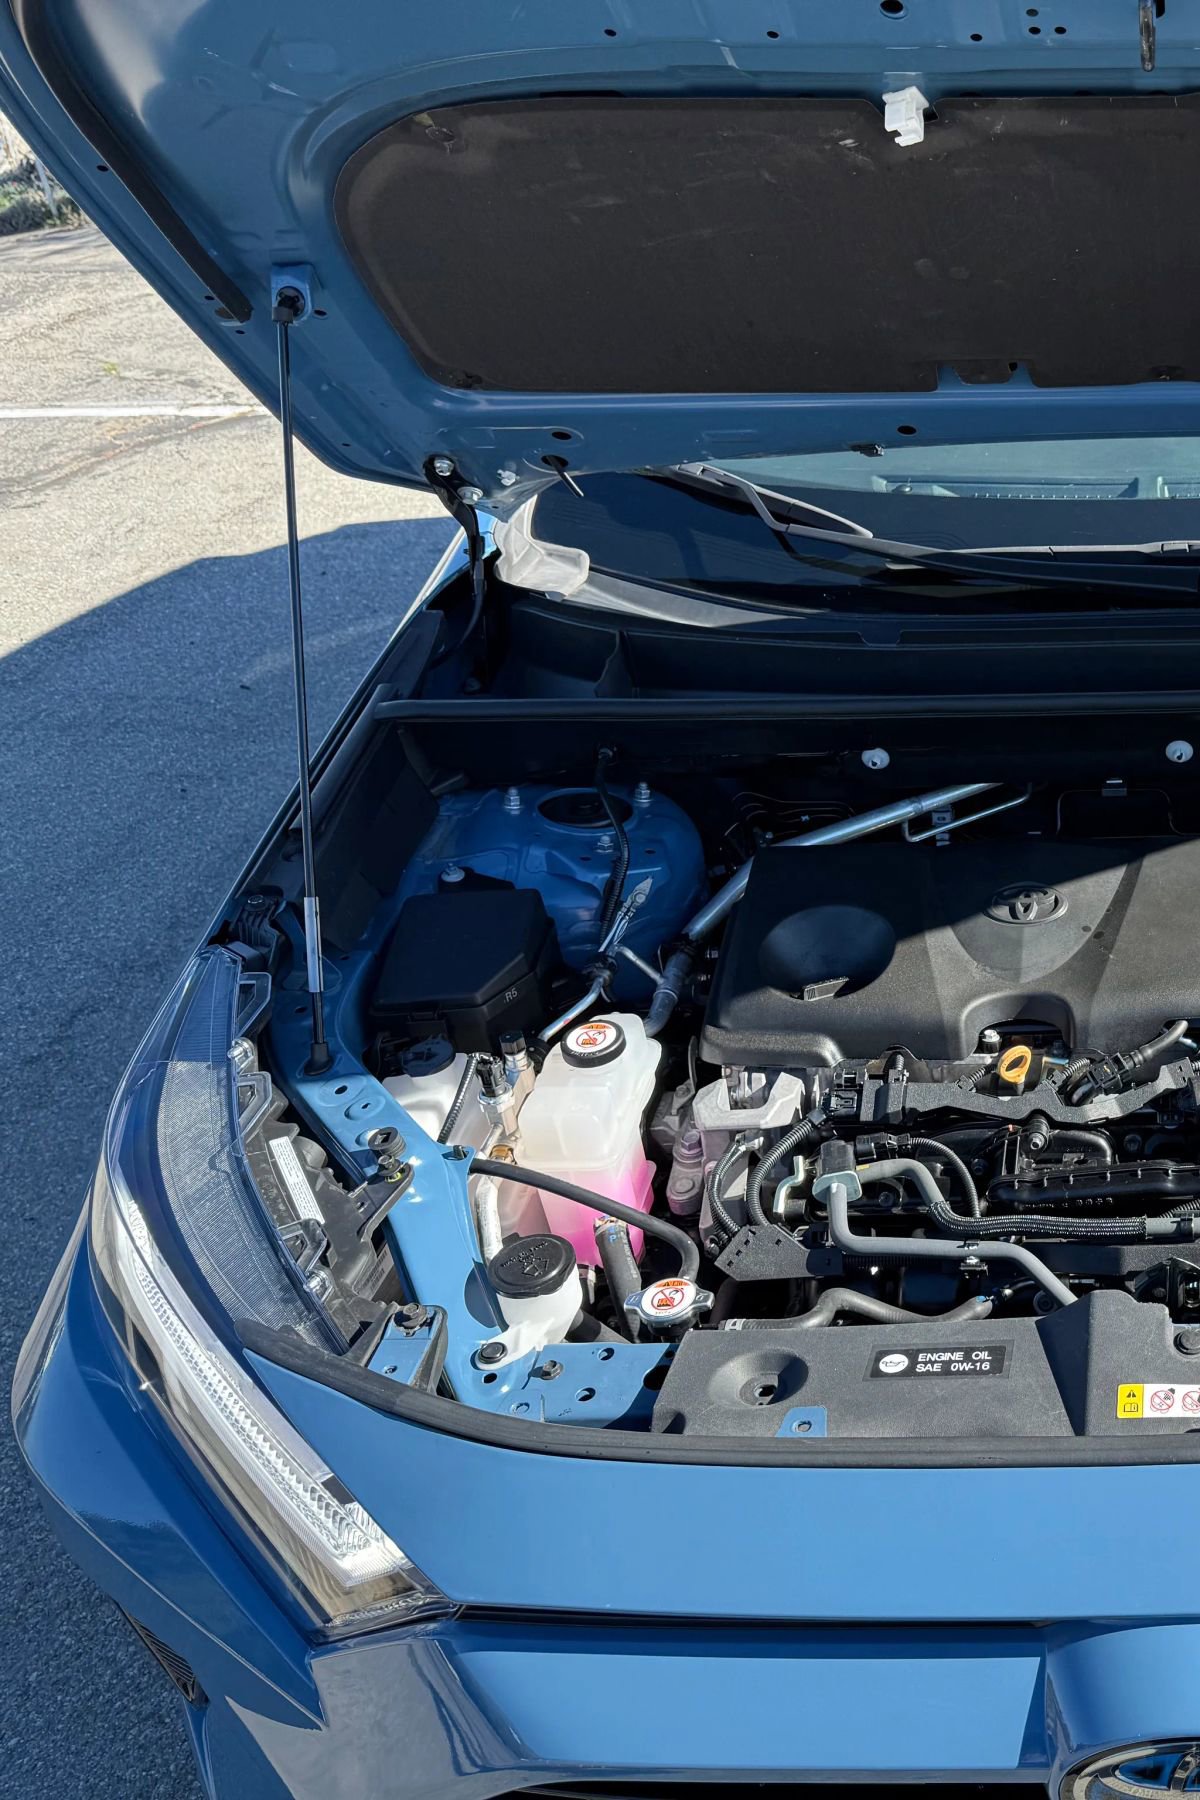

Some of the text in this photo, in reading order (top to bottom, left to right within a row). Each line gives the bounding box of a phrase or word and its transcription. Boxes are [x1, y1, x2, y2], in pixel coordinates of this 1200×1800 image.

[917, 1351, 993, 1362] ENGINE OIL
[915, 1362, 990, 1372] SAE 0W-16
